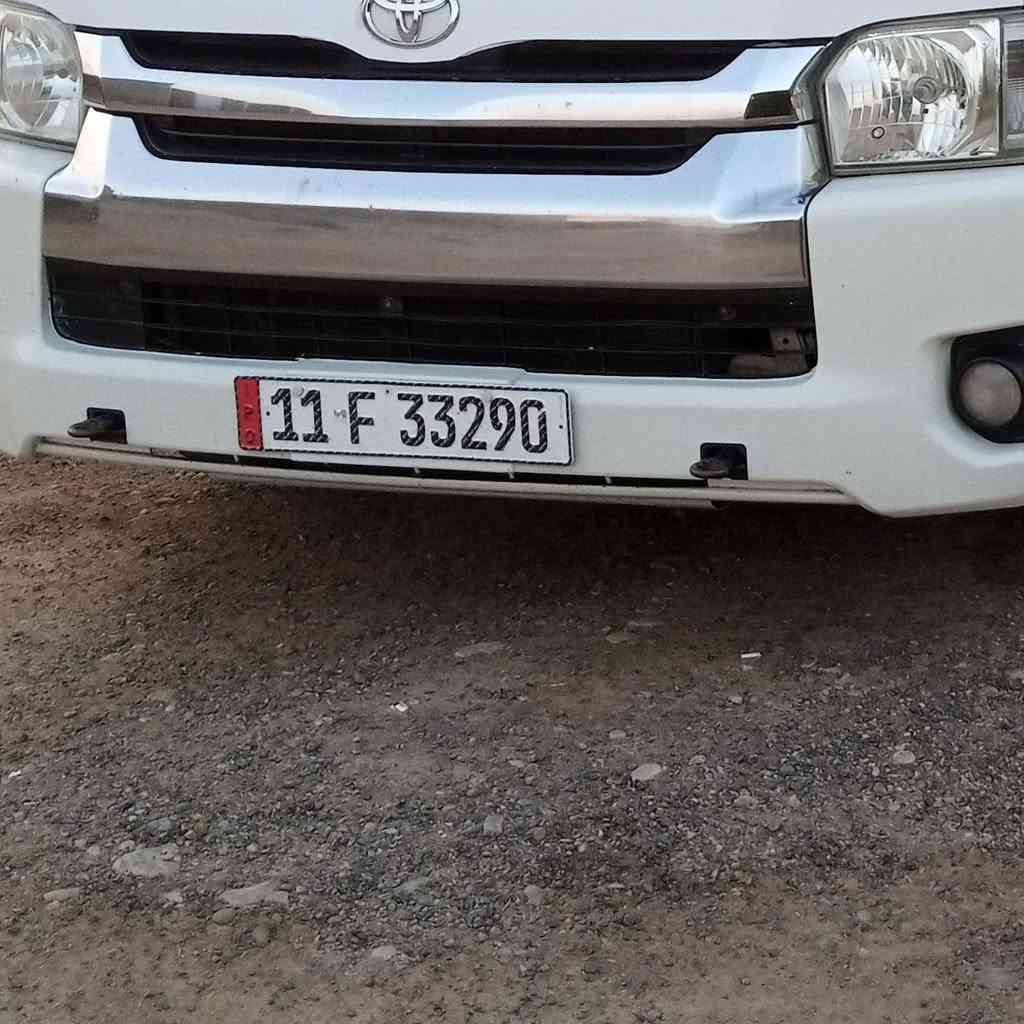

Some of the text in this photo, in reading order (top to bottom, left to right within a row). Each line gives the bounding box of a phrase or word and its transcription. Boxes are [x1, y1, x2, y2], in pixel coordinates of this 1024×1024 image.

[271, 387, 548, 454] 11 F 33290
